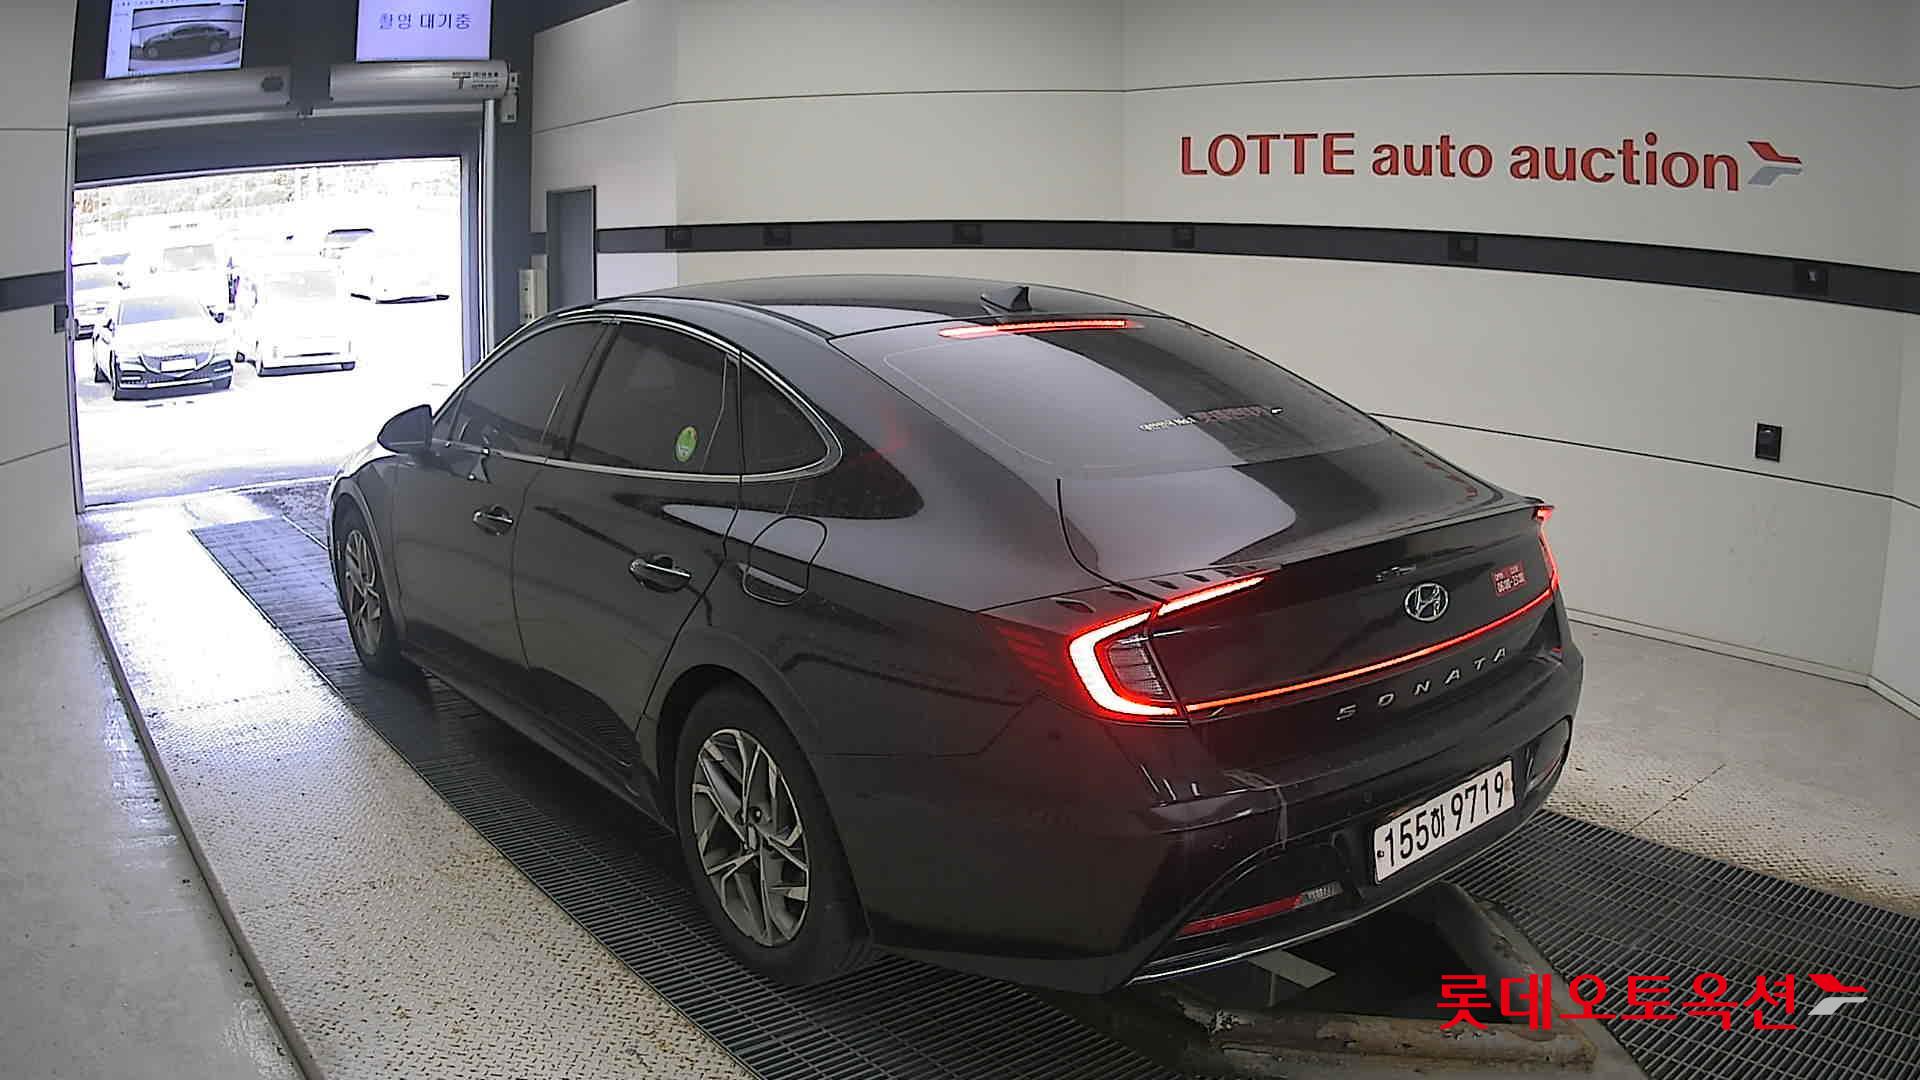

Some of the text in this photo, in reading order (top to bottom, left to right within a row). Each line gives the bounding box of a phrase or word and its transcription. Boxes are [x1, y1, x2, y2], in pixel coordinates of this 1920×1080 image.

[420, 13, 473, 30] 대기중
[1180, 131, 1740, 191] LOTTE auto auction
[1335, 647, 1507, 721] SONATA
[1384, 770, 1504, 867] 155하 9719
